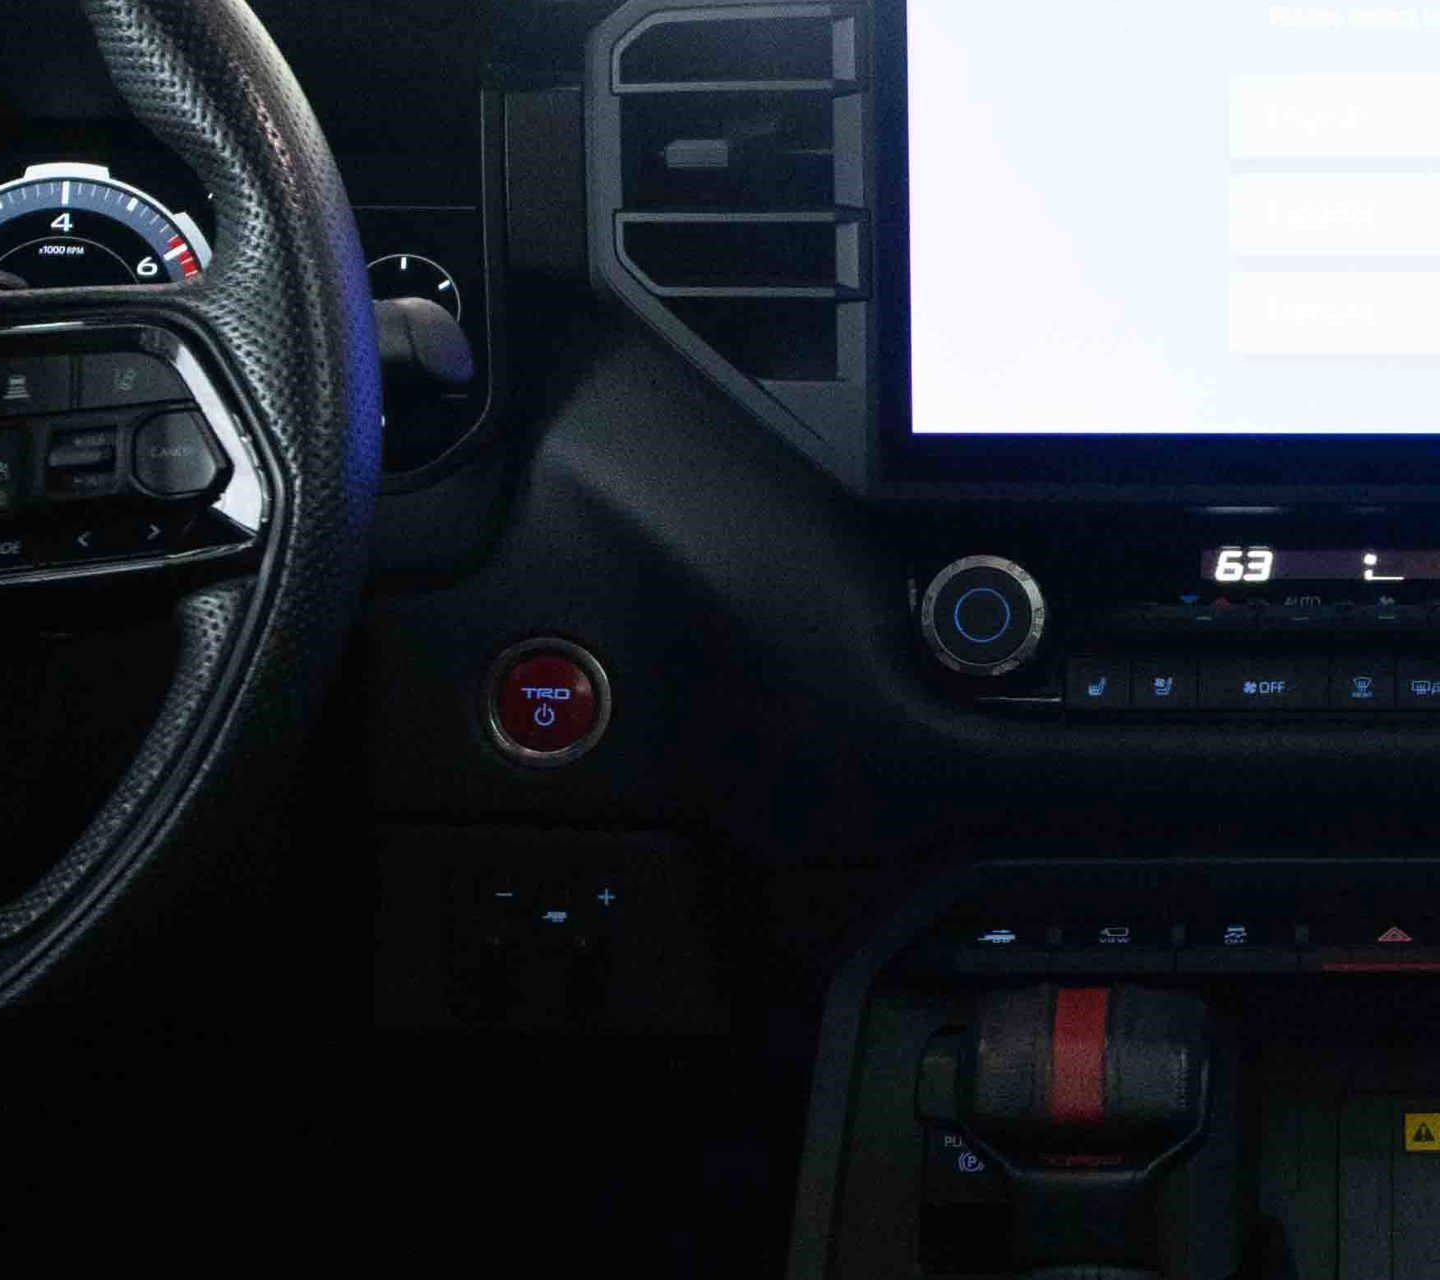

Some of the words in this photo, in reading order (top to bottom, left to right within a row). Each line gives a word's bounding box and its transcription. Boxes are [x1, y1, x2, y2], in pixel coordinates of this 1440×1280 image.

[50, 212, 74, 233] 4
[136, 255, 159, 277] 6
[1214, 549, 1274, 583] 63
[519, 686, 572, 702] TRD
[1259, 681, 1286, 694] OFF
